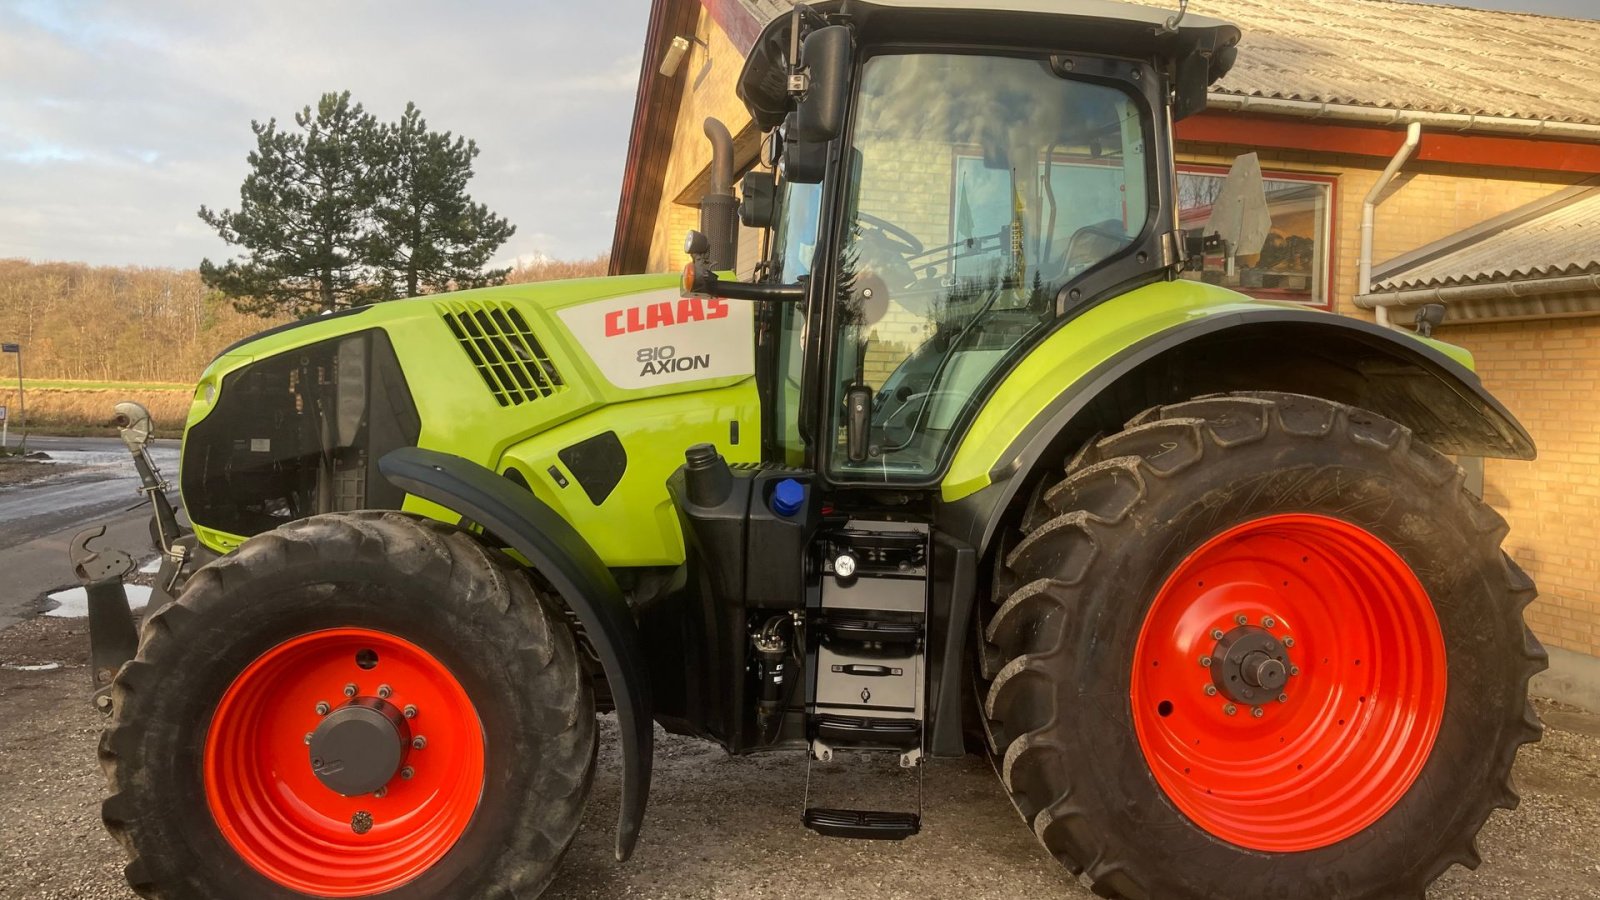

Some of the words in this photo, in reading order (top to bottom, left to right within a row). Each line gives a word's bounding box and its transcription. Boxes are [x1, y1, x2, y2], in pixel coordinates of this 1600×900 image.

[605, 297, 728, 337] CLAAS
[636, 345, 675, 363] 810
[639, 354, 710, 377] AXION
